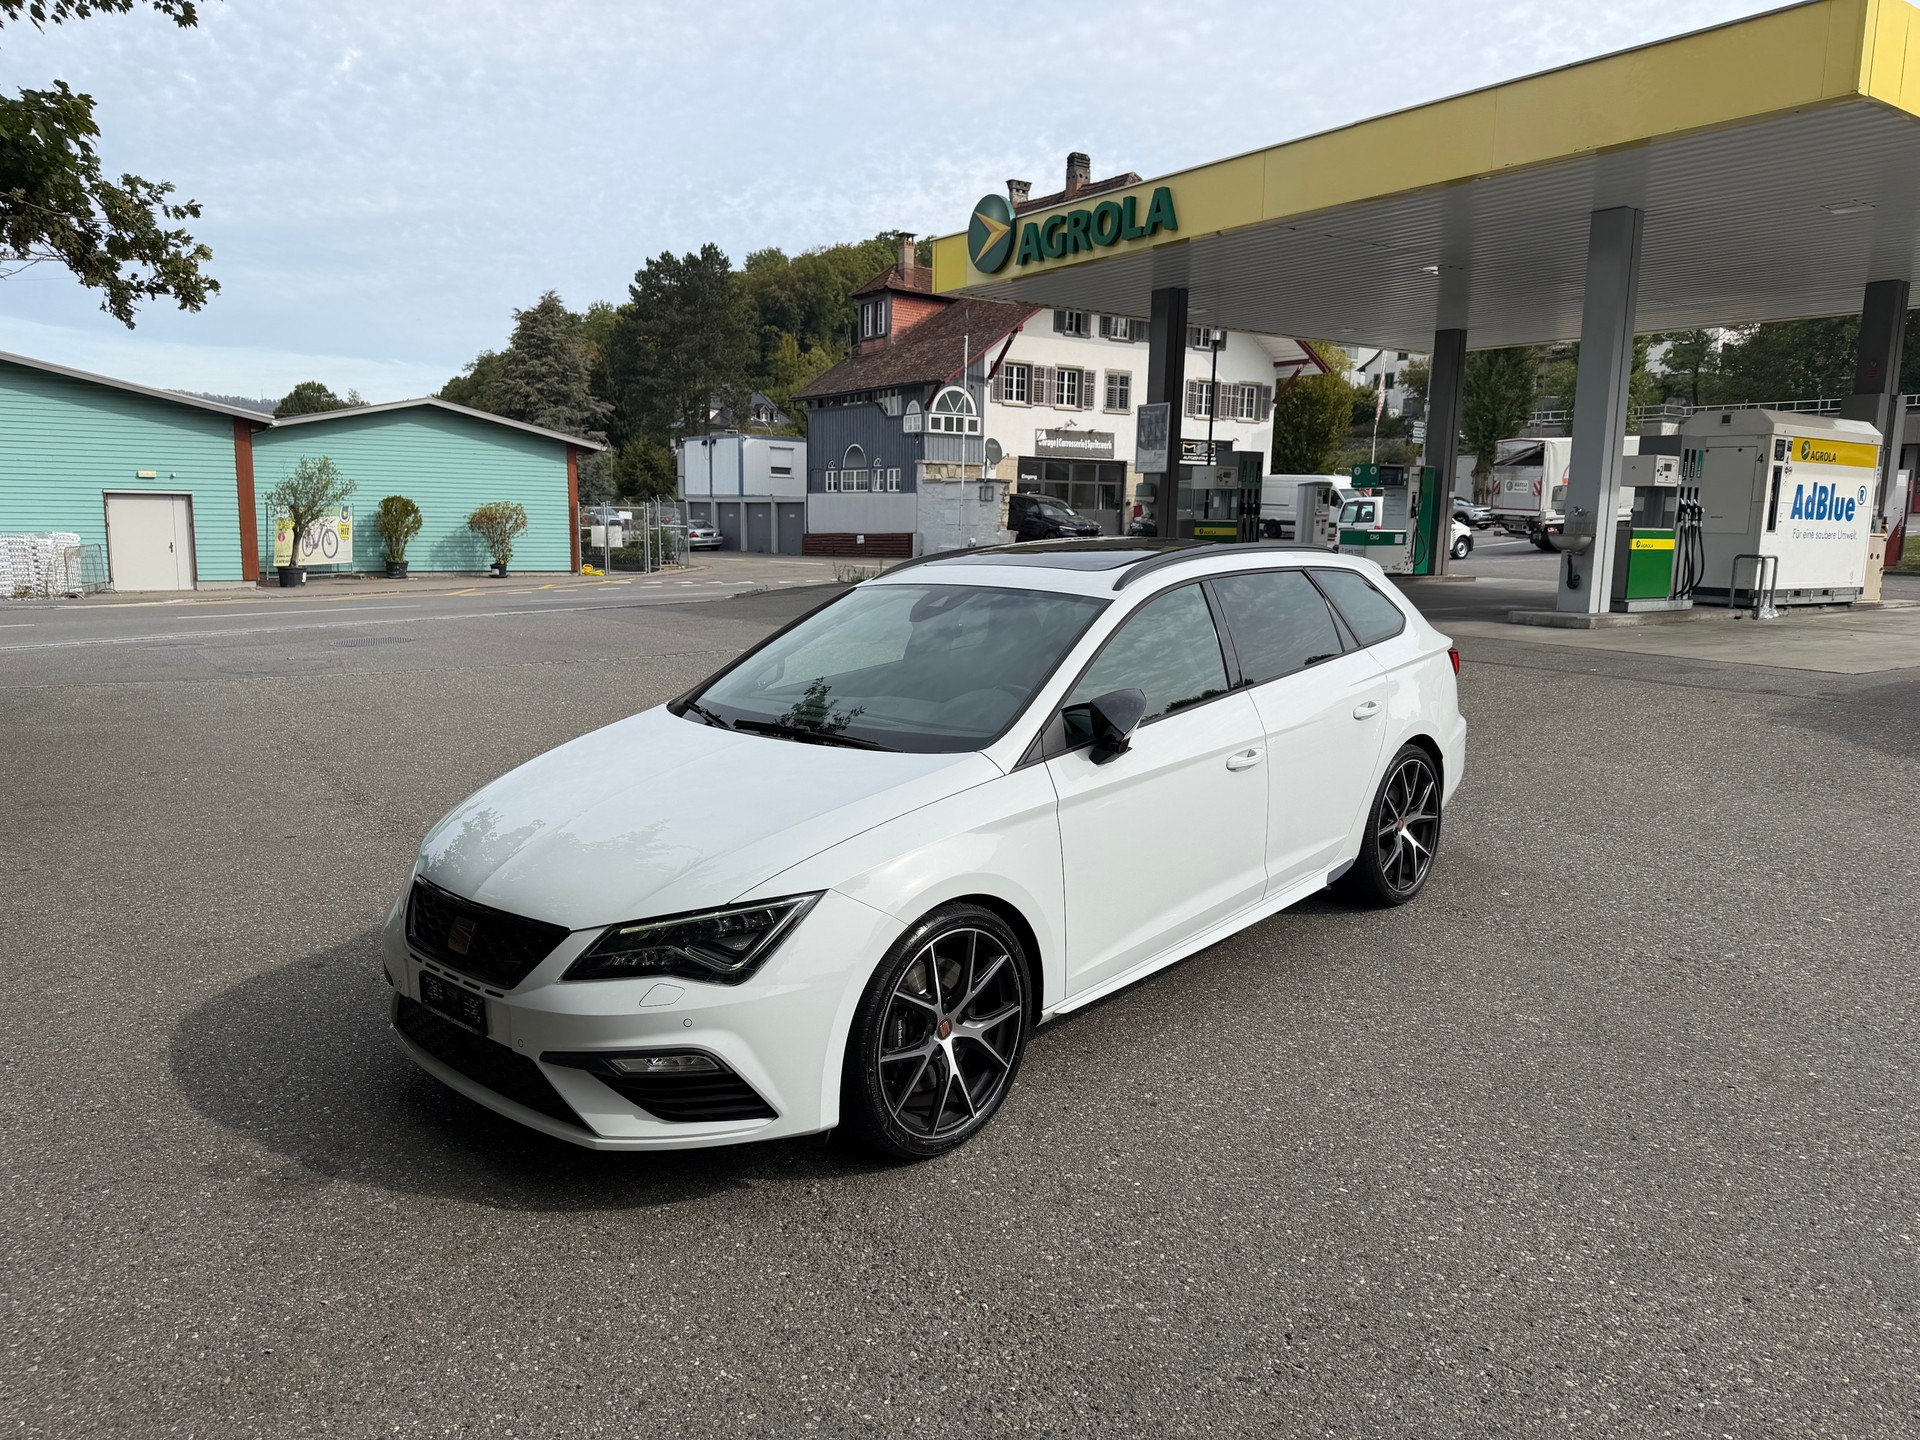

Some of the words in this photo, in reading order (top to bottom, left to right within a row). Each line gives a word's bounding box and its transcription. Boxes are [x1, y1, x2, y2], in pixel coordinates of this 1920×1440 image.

[1016, 187, 1178, 267] AGROLA
[1757, 453, 1764, 464] 4
[1810, 450, 1837, 463] AGROLA
[340, 527, 350, 535] HIT
[1792, 528, 1802, 539] Für
[1802, 529, 1815, 539] eine
[1815, 529, 1837, 540] saubere
